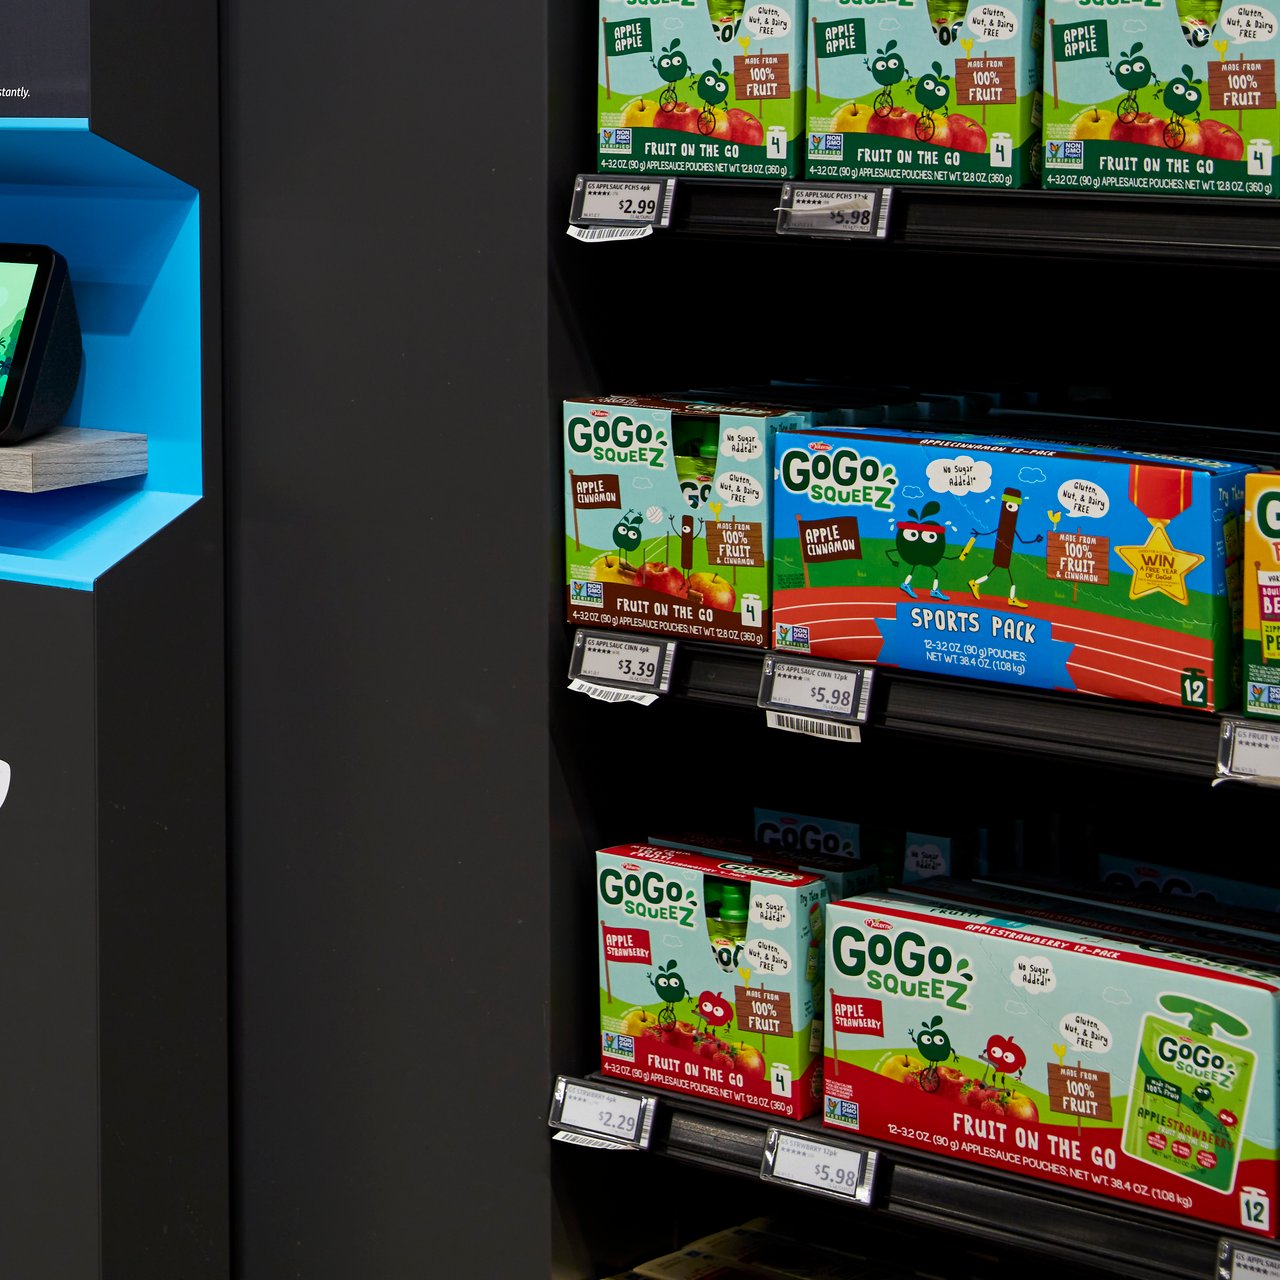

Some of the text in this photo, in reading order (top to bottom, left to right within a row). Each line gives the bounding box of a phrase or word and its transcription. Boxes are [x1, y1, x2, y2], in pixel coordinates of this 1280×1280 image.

[614, 23, 642, 39] APPLE
[615, 36, 642, 51] APPLE
[750, 68, 775, 80] 100%
[746, 83, 778, 96] FRUIT
[644, 142, 739, 158] FRUIT ON THE GO
[619, 199, 656, 215] $2.99
[568, 416, 653, 453] GoGo
[593, 447, 664, 468] SQUEEZ
[782, 449, 880, 492] GoGo
[810, 484, 893, 508] SQUEEZ
[805, 525, 838, 544] APPLE
[807, 539, 855, 556] CINNAMON
[1141, 553, 1175, 569] WIN
[910, 607, 1036, 643] SPORTS PACK
[618, 660, 656, 678] $3.39
[811, 687, 851, 706] $5.98
[1184, 680, 1203, 702] 12
[599, 868, 683, 905] GoGo
[624, 899, 694, 928] SQUEEZ
[832, 926, 952, 977] GoGo
[866, 970, 969, 1011] SQUEEZ
[835, 1004, 864, 1018] APPLE
[835, 1016, 881, 1030] STRAWBERRY
[599, 1111, 635, 1132] $2.29
[953, 1112, 1117, 1170] FRUIT ON THE GO
[814, 1164, 856, 1187] $5.98
[1244, 1202, 1265, 1224] 12
